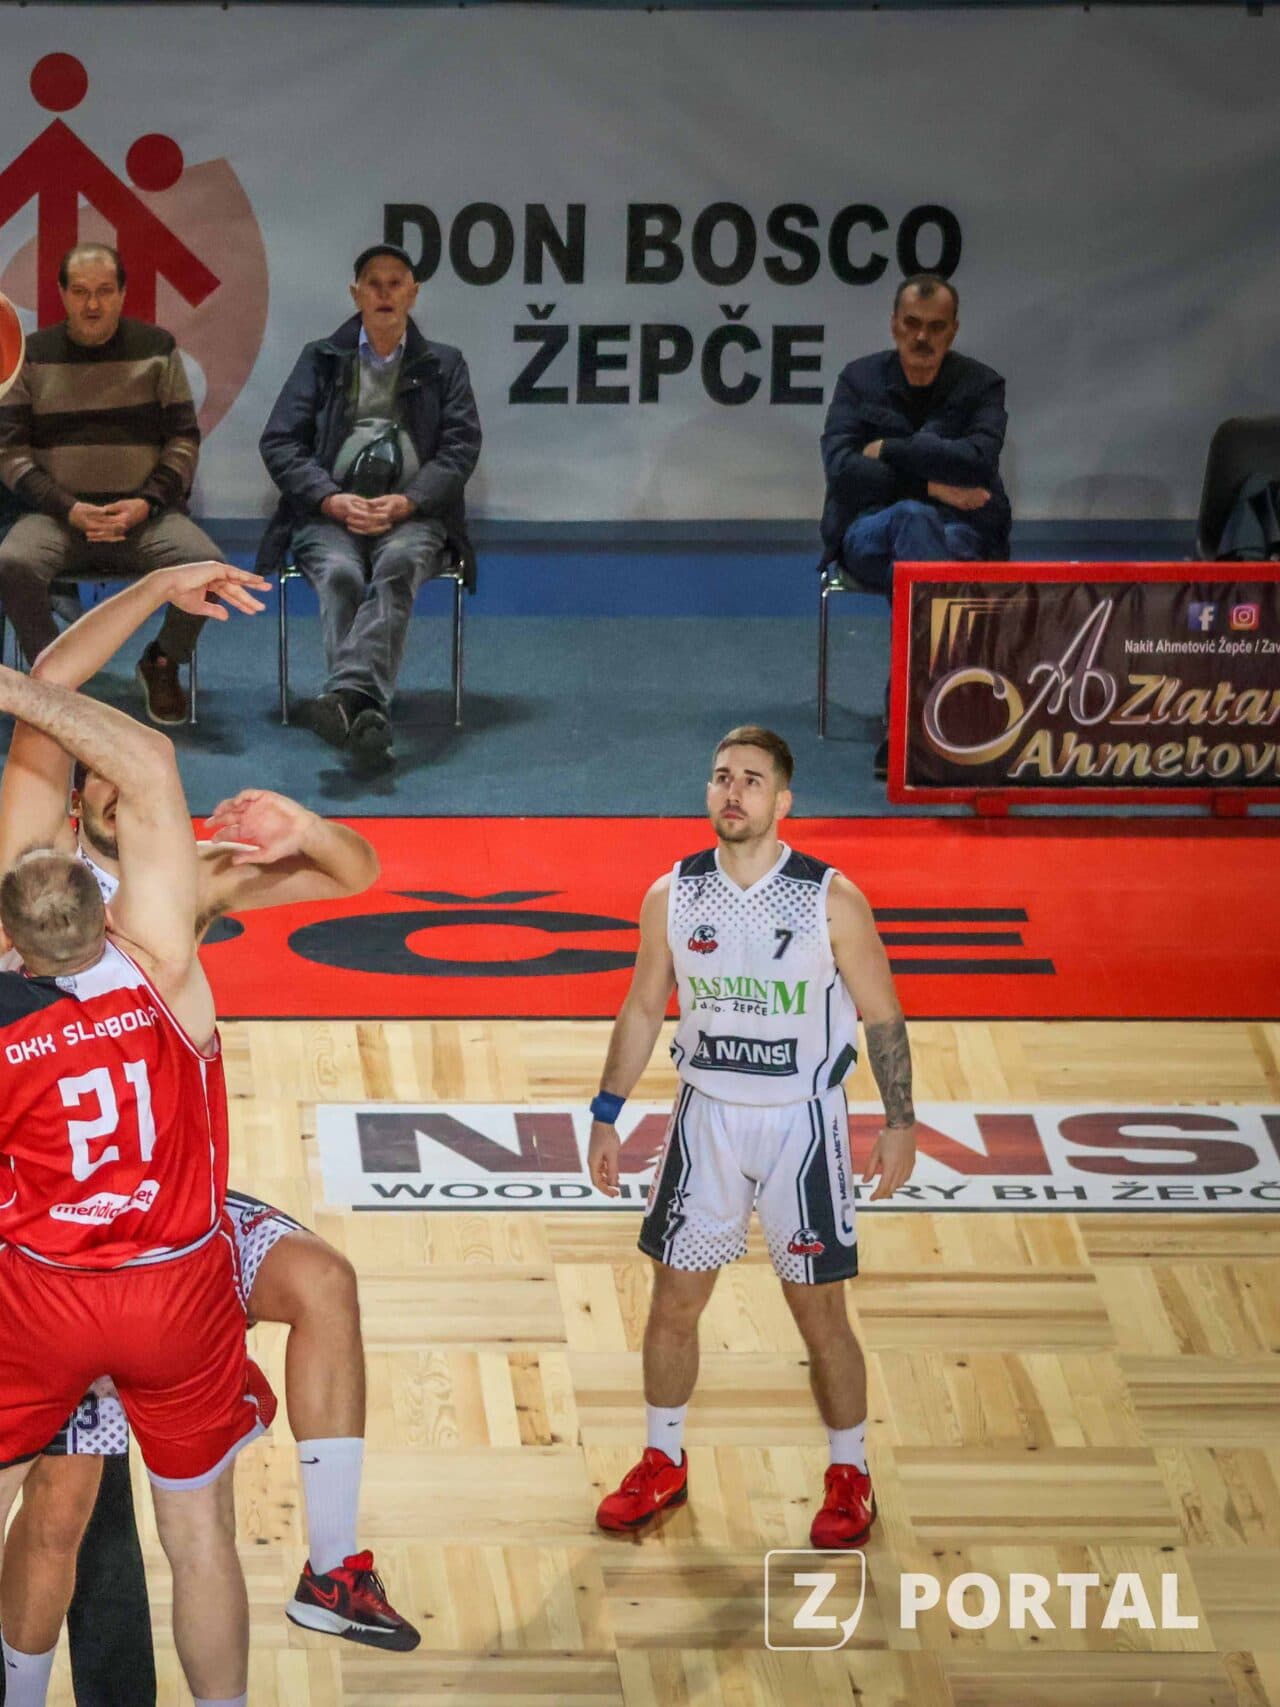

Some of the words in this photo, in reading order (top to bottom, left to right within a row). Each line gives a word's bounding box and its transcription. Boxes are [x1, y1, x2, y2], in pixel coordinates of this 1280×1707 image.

[383, 202, 586, 286] DON
[625, 202, 962, 287] BOSCO
[508, 304, 824, 405] ŽEPČE
[1124, 639, 1154, 654] Nakit
[1108, 674, 1280, 725] Zlata
[1006, 729, 1280, 778] Ahmetov
[773, 929, 793, 959] 7
[732, 1000, 768, 1016] ŽEPČE
[770, 979, 810, 1015] M
[5, 1034, 56, 1064] OKK
[715, 1040, 792, 1065] NANSI
[57, 1059, 157, 1182] 21
[371, 1183, 593, 1199] WOOD
[992, 1185, 1088, 1201] BH
